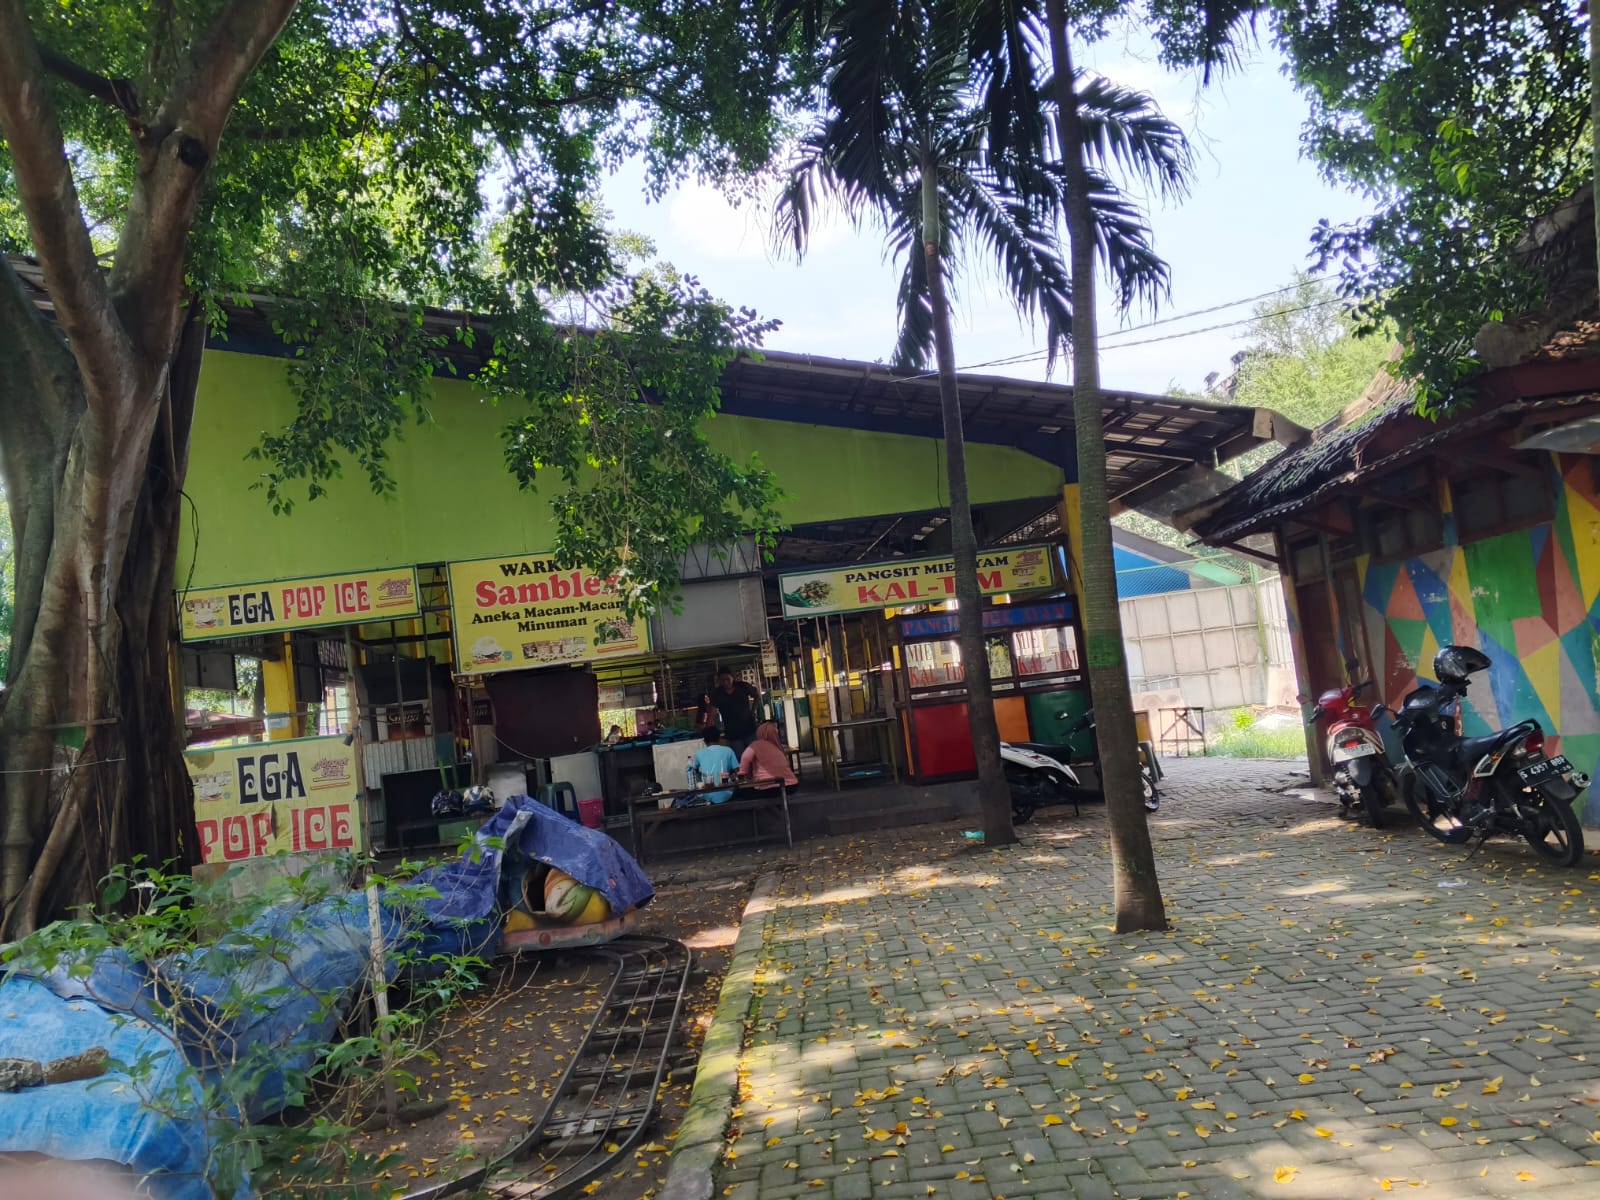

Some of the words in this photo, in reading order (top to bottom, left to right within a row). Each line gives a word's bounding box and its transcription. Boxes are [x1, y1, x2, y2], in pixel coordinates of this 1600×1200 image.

[845, 566, 920, 583] PANGSIT
[924, 562, 955, 575] MIE
[858, 570, 1002, 604] KAL-TM
[228, 591, 275, 626] EGA
[282, 585, 325, 620] POP
[334, 580, 371, 614] ICE
[472, 609, 520, 624] Aneka
[518, 617, 587, 633] Minuman
[908, 644, 932, 661] MIE
[237, 751, 307, 805] EGA
[195, 812, 274, 865] POP
[291, 804, 353, 853] ICE
